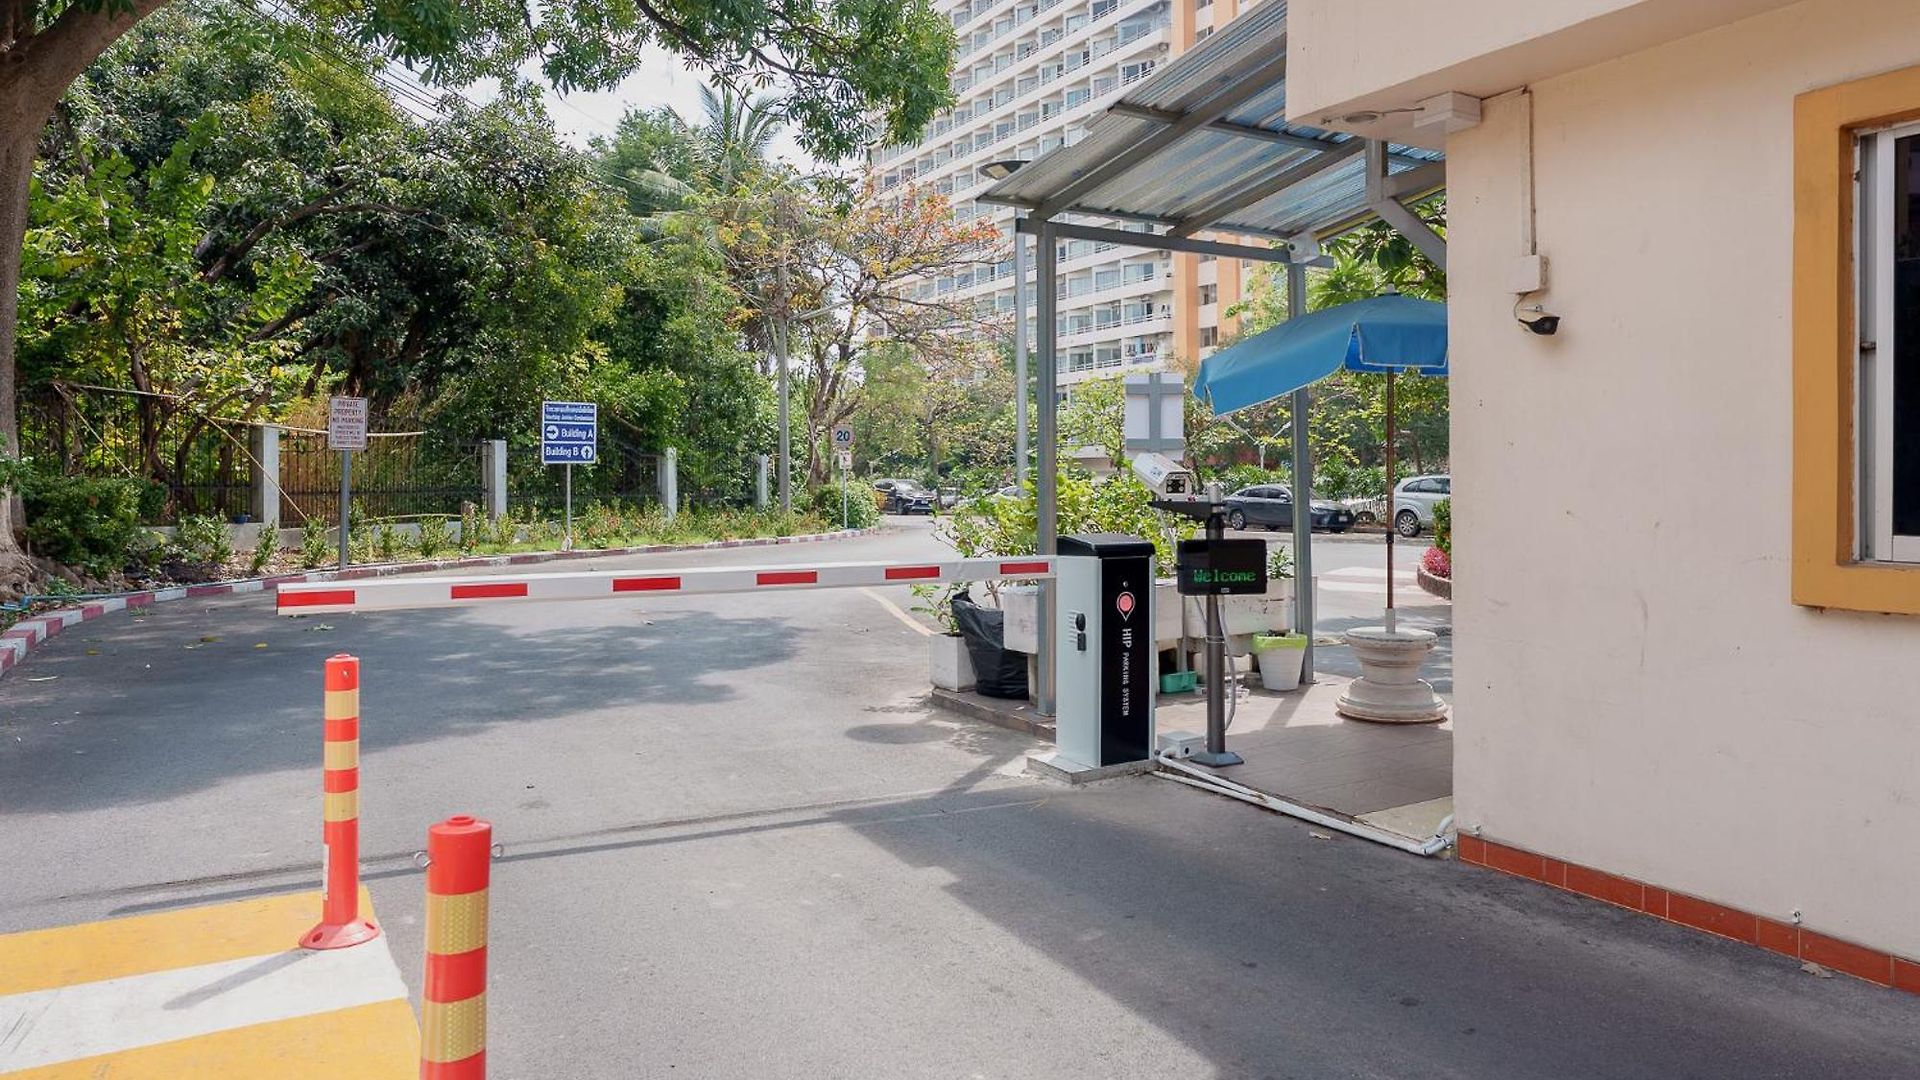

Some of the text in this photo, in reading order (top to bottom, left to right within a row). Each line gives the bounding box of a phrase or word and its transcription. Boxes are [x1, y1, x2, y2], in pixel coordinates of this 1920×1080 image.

[561, 428, 594, 440] Building A
[836, 430, 851, 442] 20
[545, 446, 580, 457] Building B
[1192, 569, 1257, 583] Welcome
[1122, 628, 1133, 716] HIP PARKING SYSTEM
